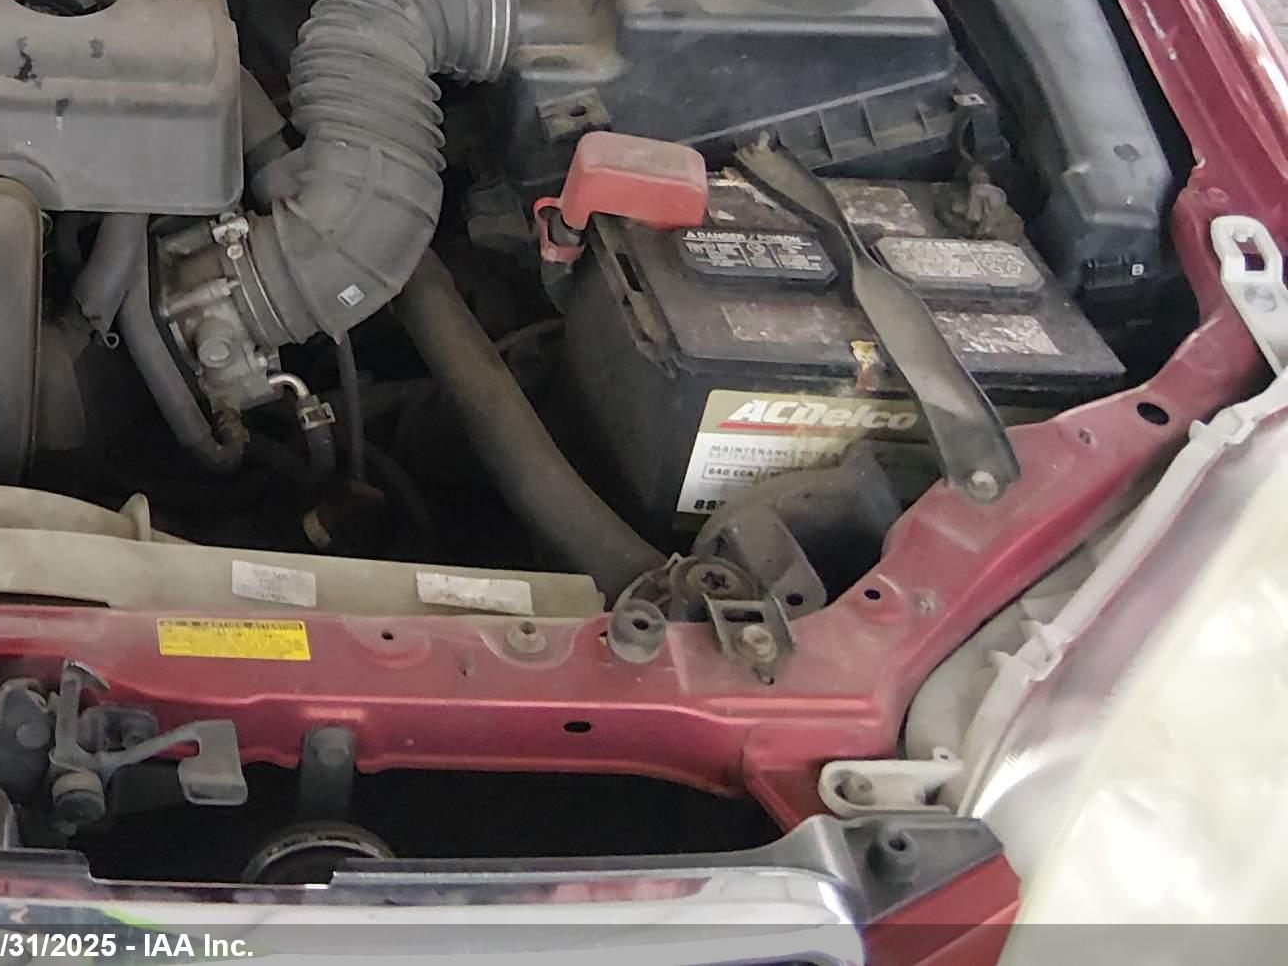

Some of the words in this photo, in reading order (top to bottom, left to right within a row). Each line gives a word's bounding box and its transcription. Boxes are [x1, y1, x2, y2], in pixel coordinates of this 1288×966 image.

[696, 231, 746, 241] DANGER
[756, 233, 802, 244] POISON
[726, 399, 918, 430] ACDelco
[709, 444, 797, 458] MAINTENANCE
[707, 467, 730, 477] 640
[732, 469, 755, 478] CCA
